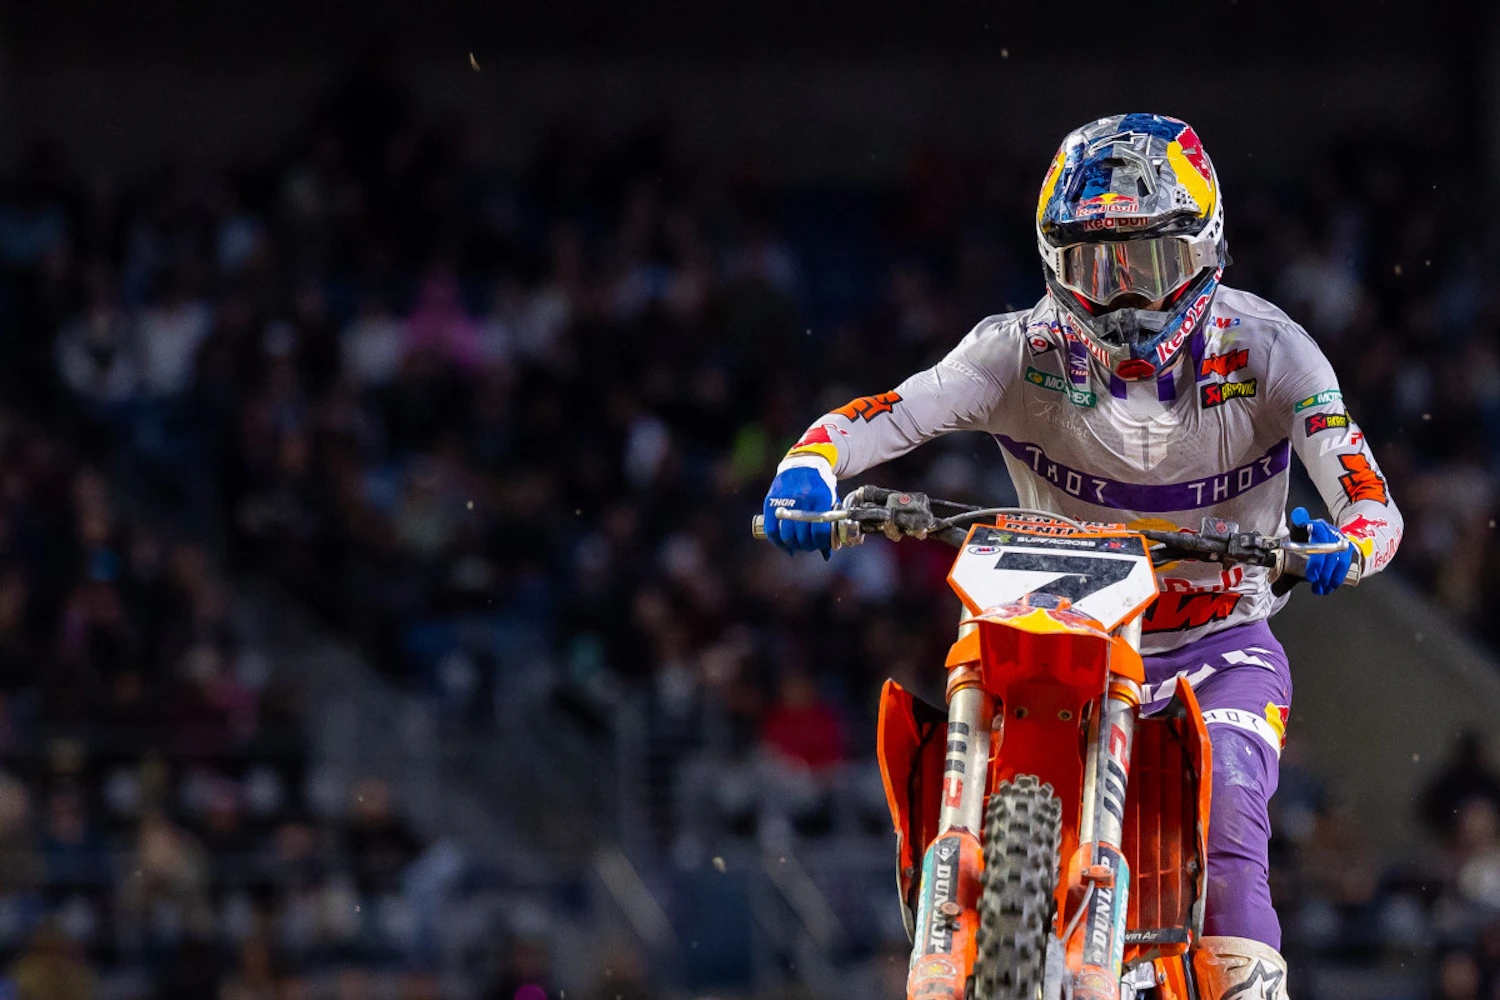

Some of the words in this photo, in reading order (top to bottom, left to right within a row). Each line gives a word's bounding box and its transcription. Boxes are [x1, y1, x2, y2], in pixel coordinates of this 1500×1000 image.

[1076, 206, 1106, 217] Red
[1026, 446, 1109, 504] THOR
[1188, 456, 1273, 505] THOR
[769, 498, 796, 507] THOR
[1016, 536, 1096, 548] SUPERCROSS
[994, 551, 1138, 605] 7
[1092, 855, 1113, 949] DUNLP
